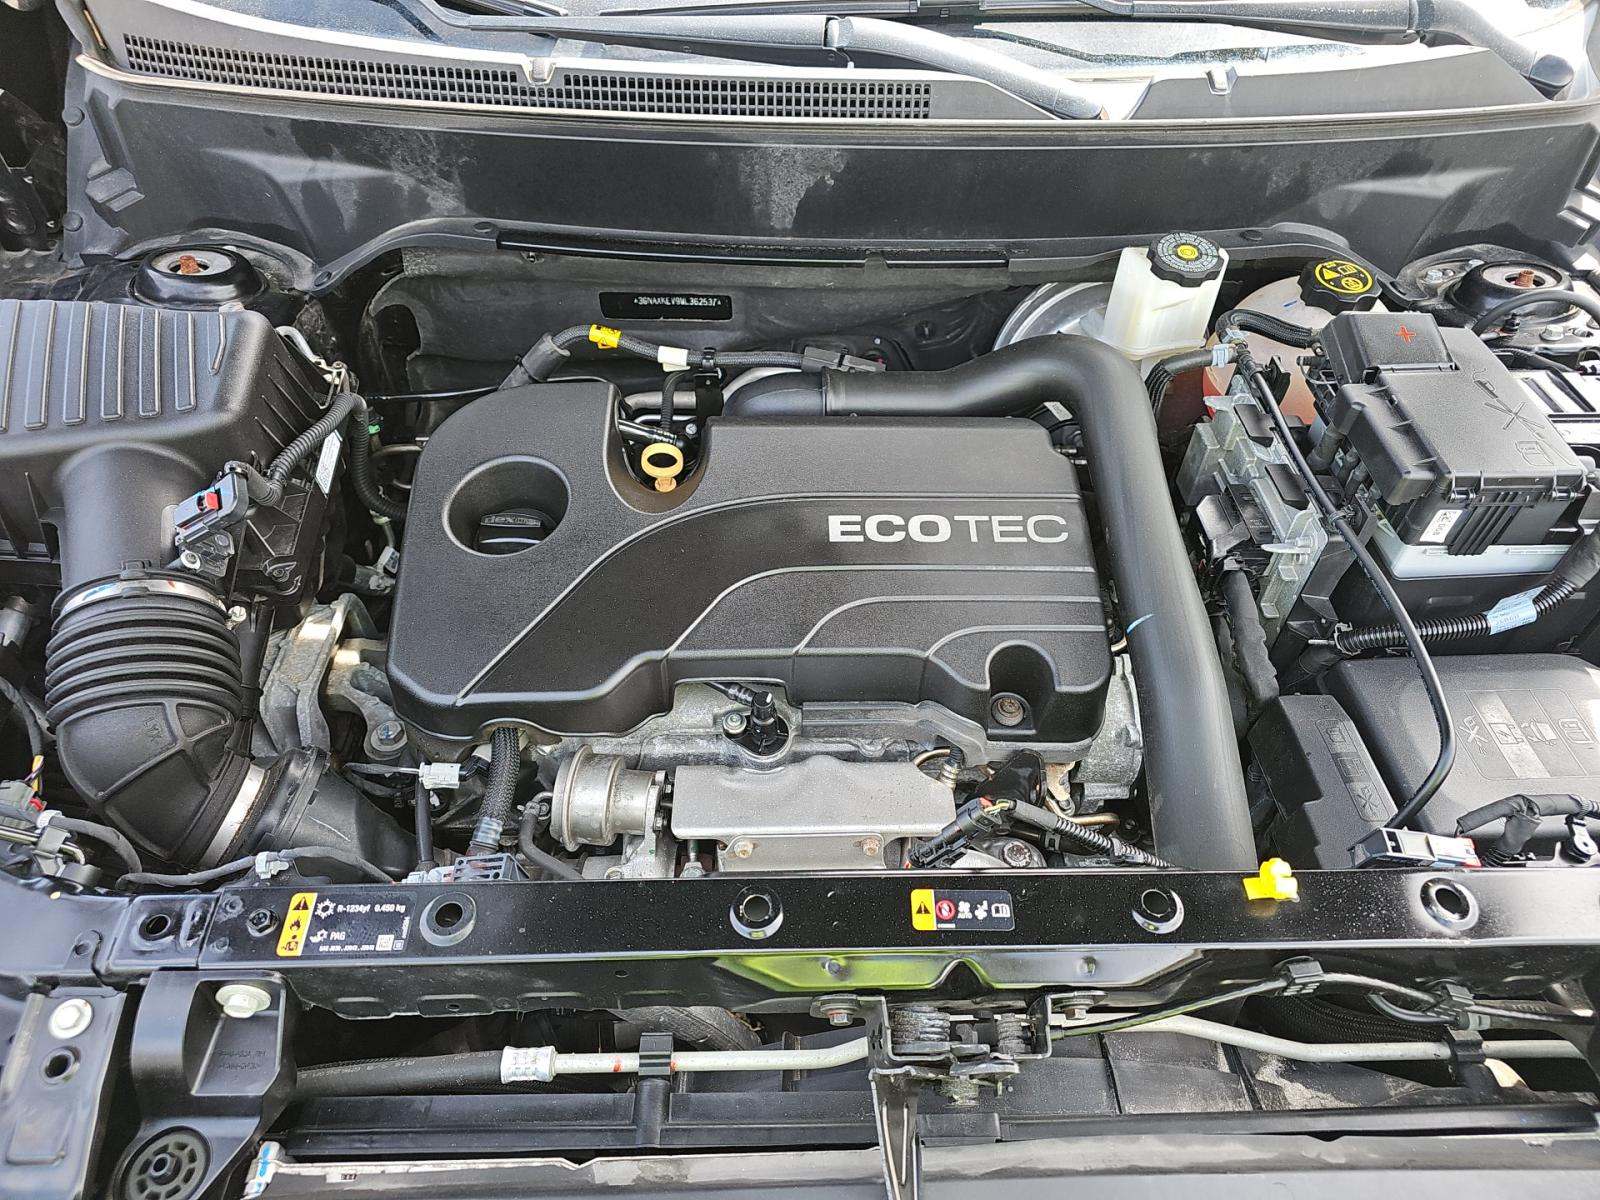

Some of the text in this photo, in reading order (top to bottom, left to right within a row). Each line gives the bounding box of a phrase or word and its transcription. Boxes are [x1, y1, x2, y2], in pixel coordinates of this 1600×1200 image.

[827, 513, 1070, 544] ECOTEC
[336, 903, 371, 914] R-1234yf
[396, 903, 406, 914] kg
[330, 931, 346, 941] PAG
